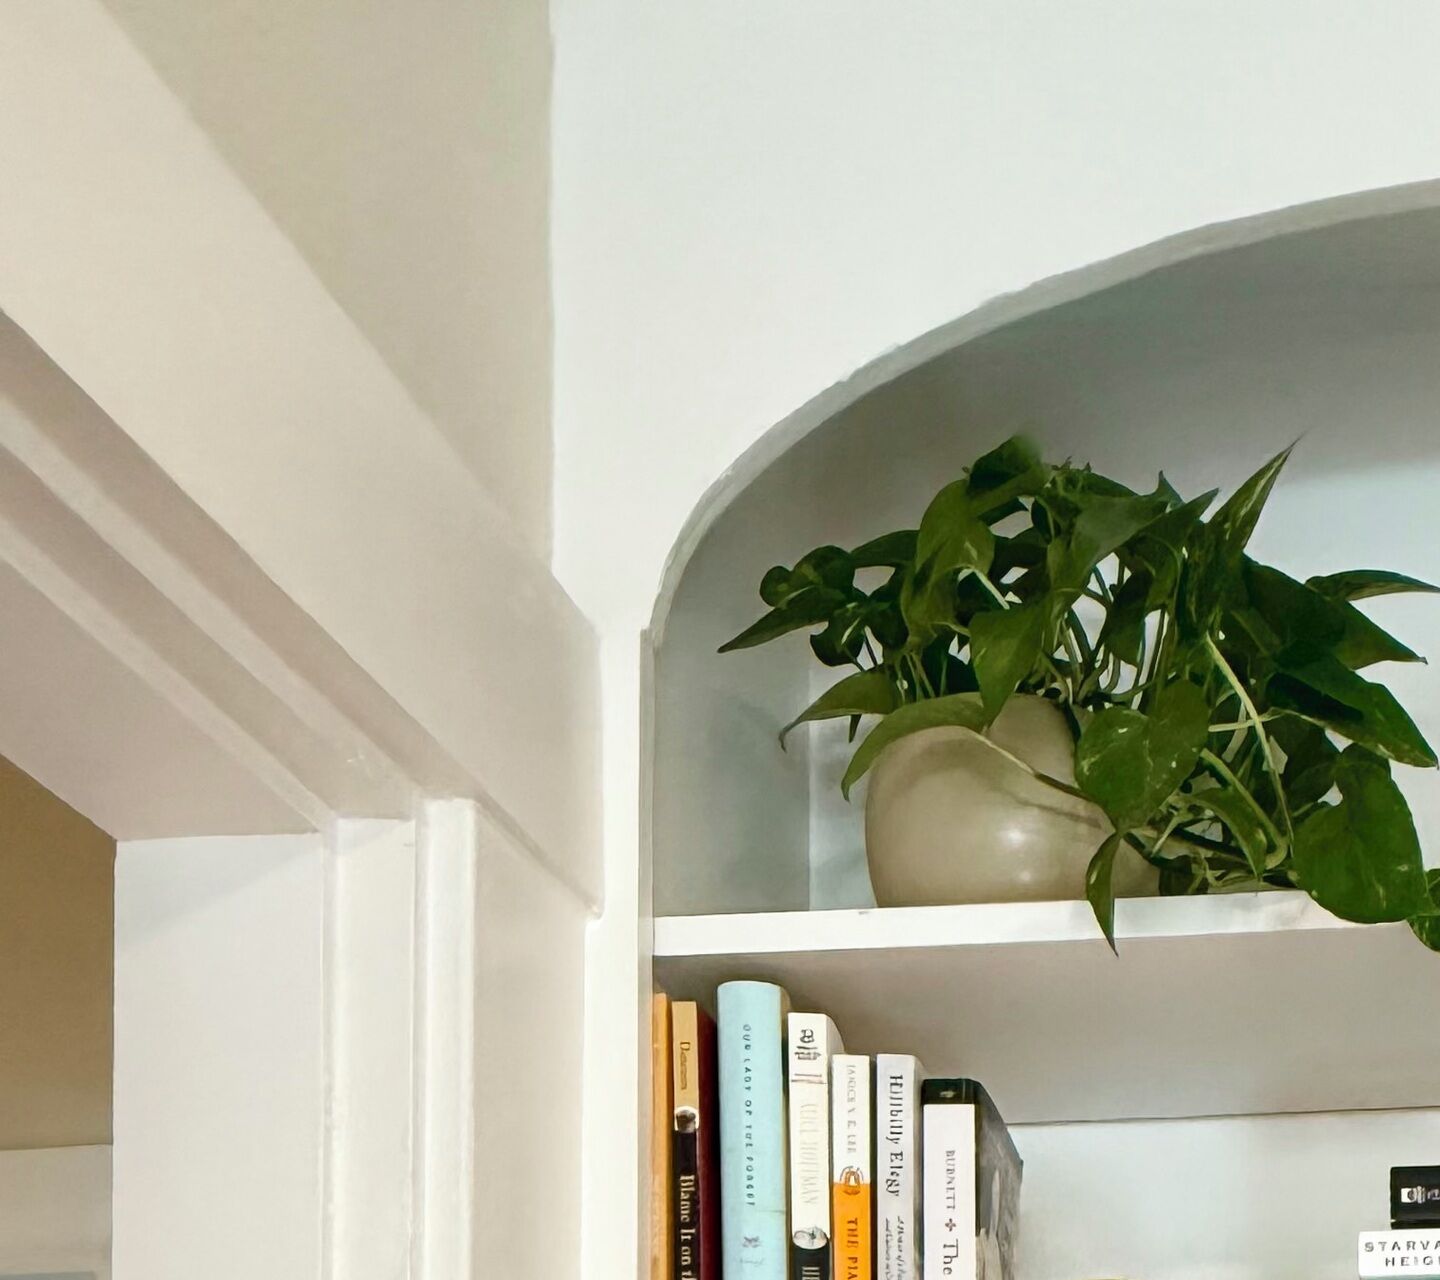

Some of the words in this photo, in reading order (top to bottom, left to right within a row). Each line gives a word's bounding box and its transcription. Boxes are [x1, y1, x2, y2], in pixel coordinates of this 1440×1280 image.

[885, 1075, 903, 1145] Hillbilly
[886, 1152, 902, 1197] Elegy
[942, 1239, 959, 1276] The
